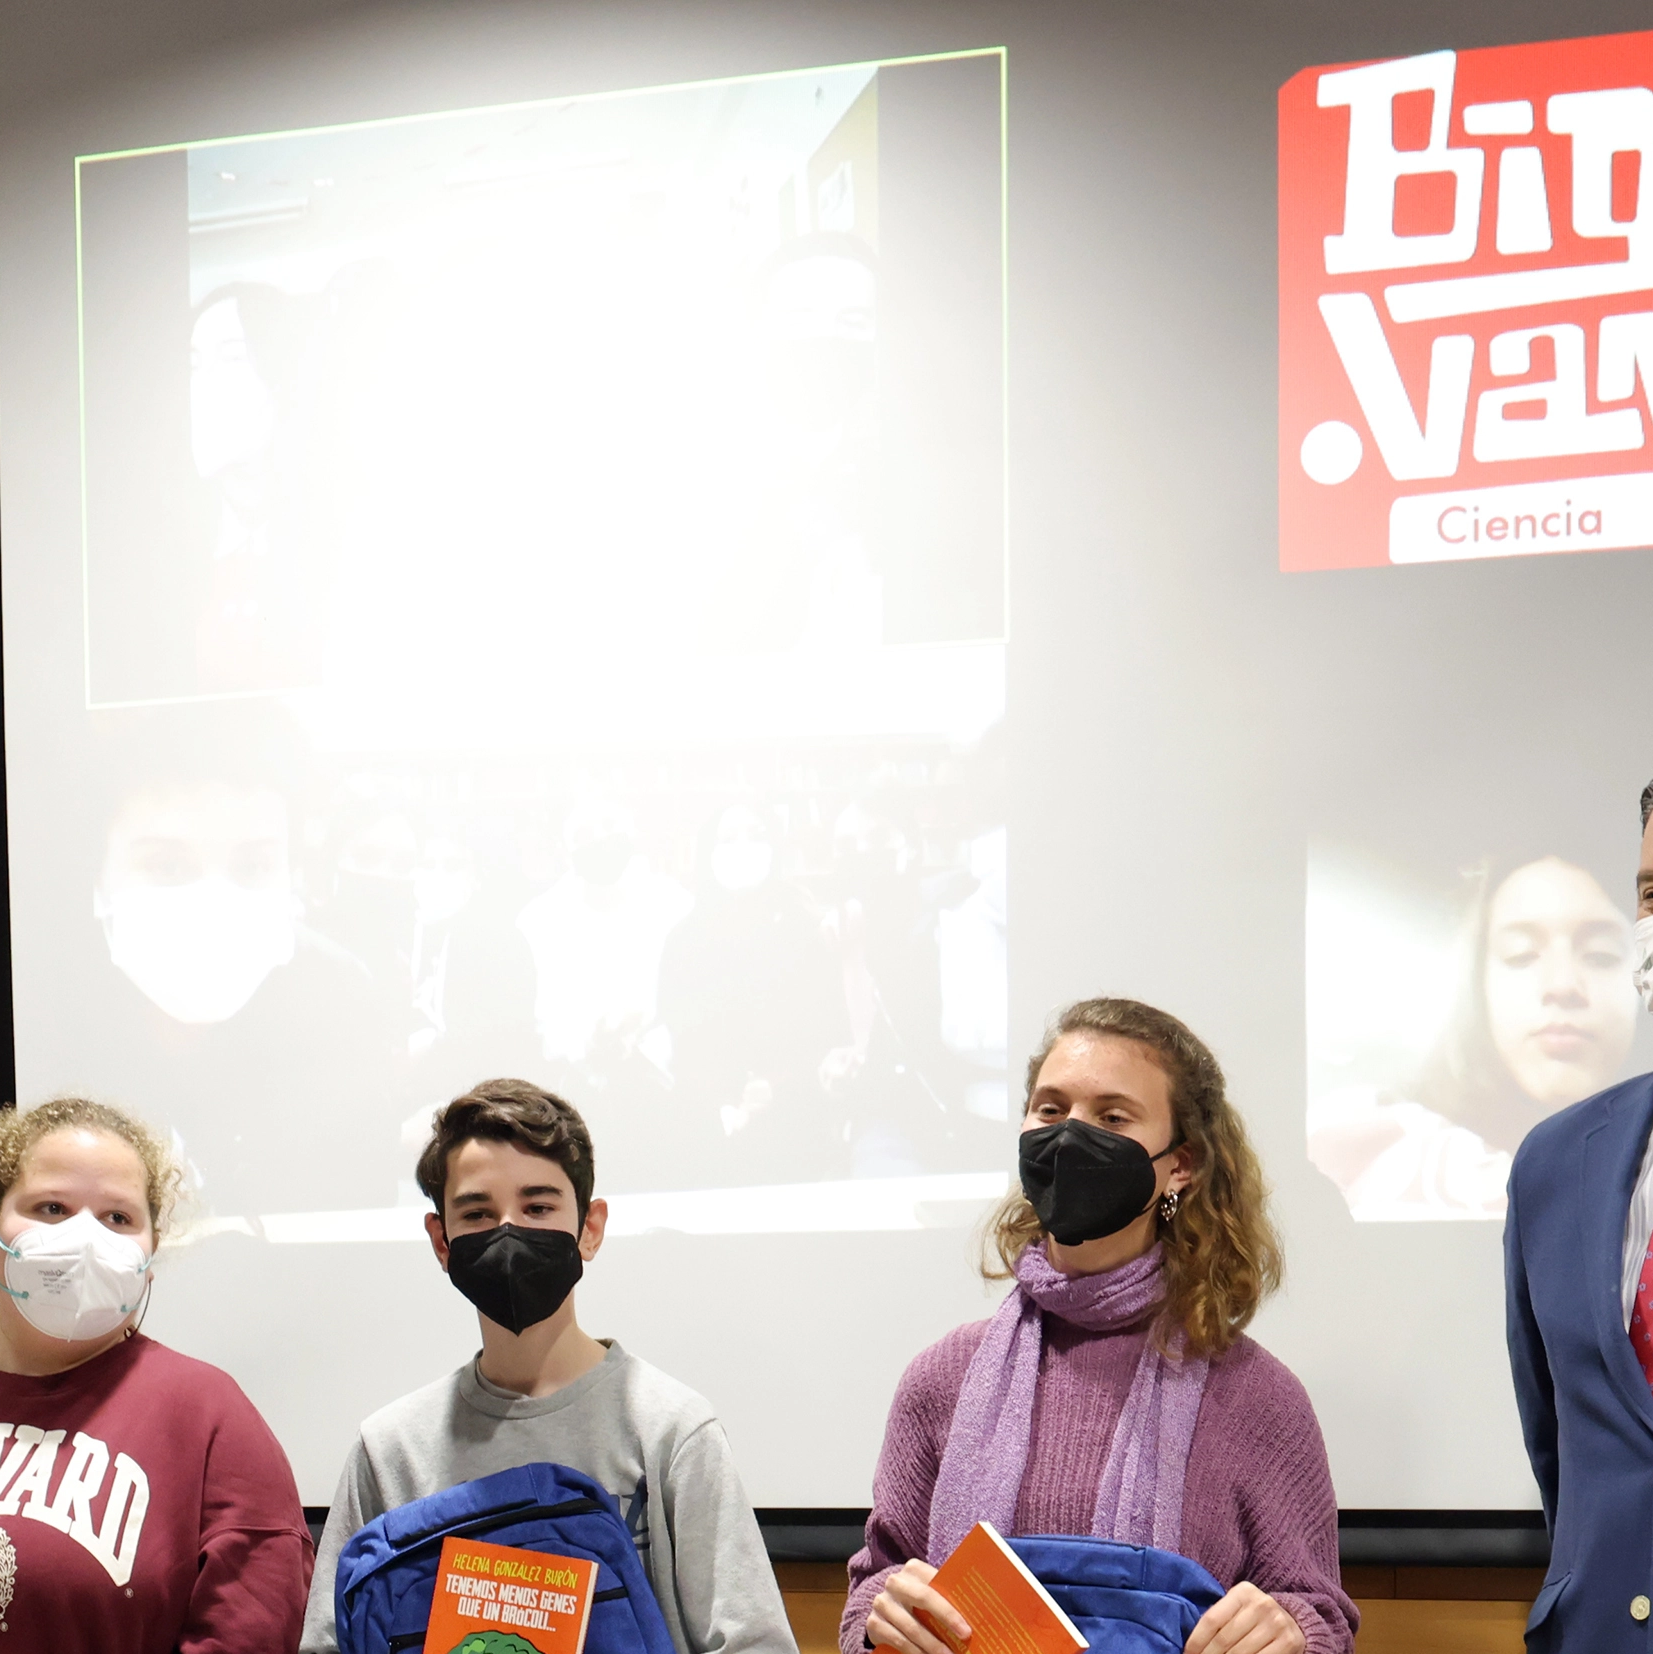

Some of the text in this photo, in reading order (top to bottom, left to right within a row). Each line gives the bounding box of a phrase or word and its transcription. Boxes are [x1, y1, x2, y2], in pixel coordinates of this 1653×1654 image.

[1437, 499, 1602, 544] Ciencia
[453, 1554, 578, 1588] HELENA GONZÁLEZ BURÓN
[446, 1574, 577, 1614] TENEMOS MENOS GENES
[458, 1597, 482, 1618] QUE
[483, 1601, 500, 1620] UN
